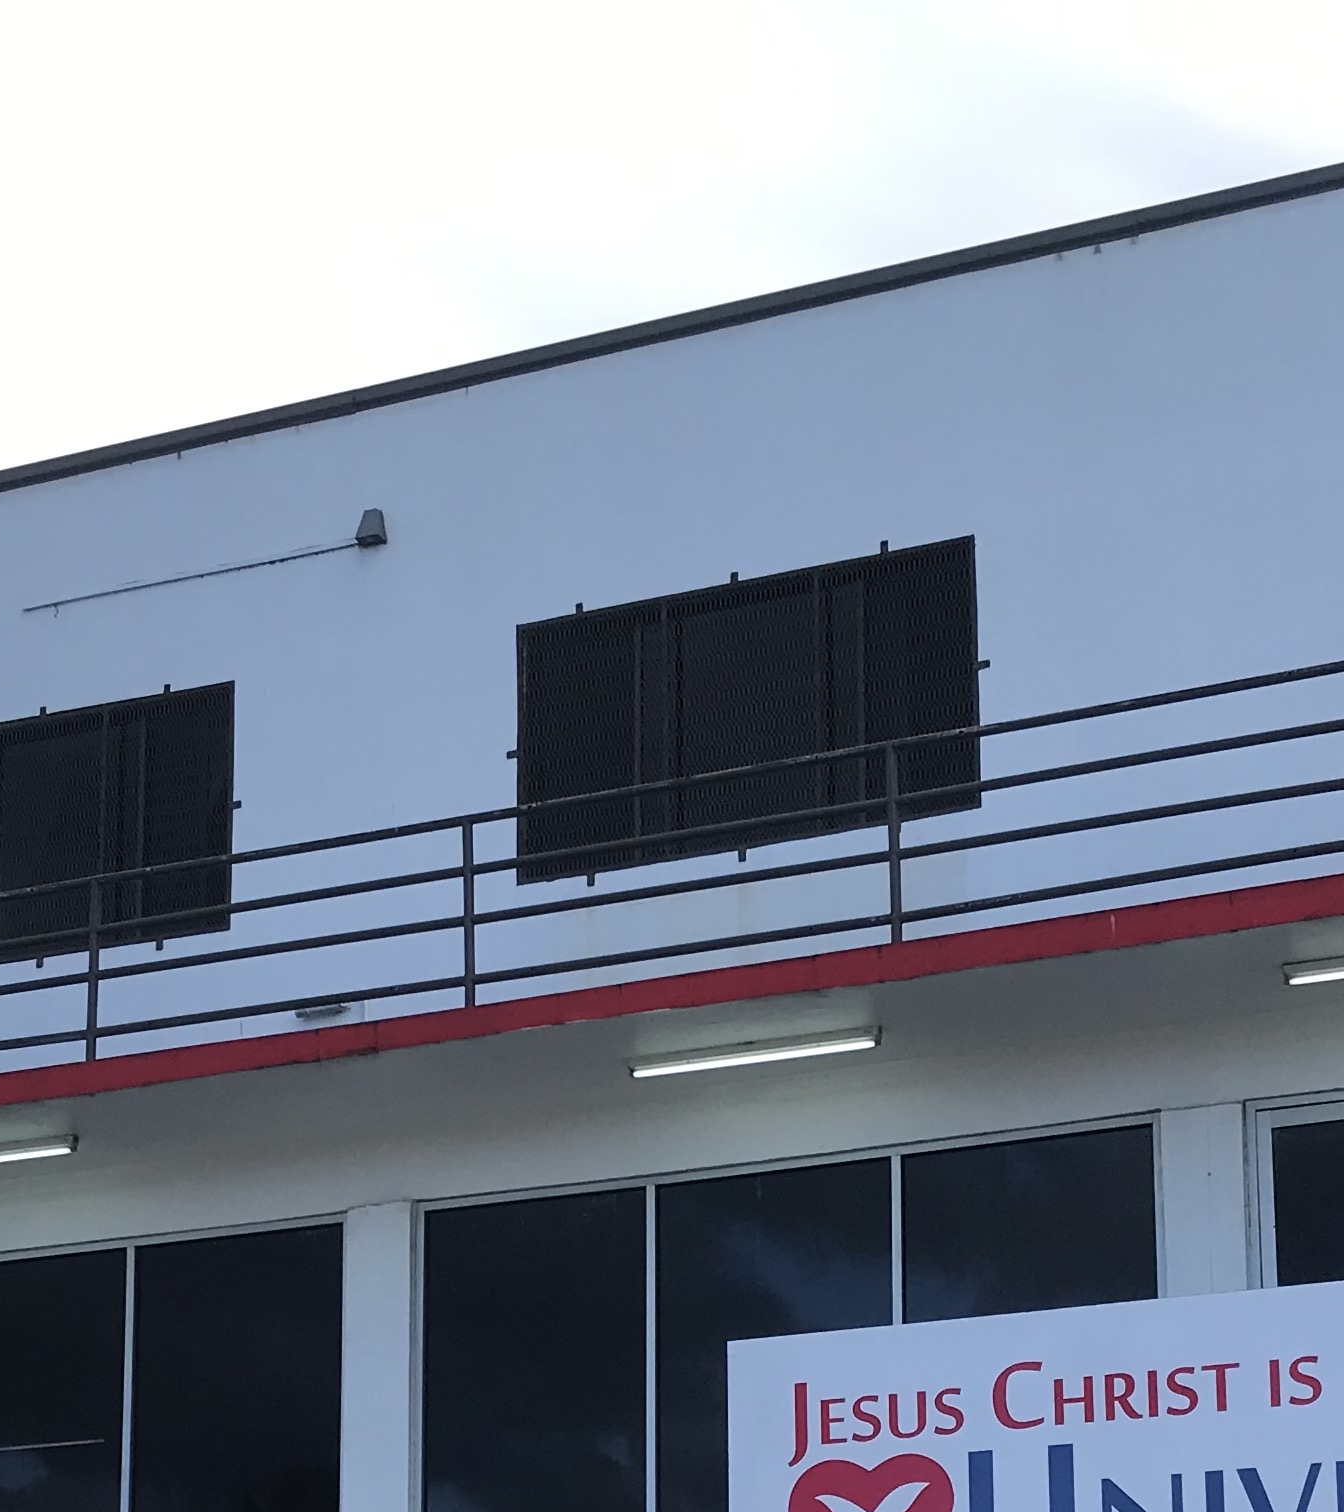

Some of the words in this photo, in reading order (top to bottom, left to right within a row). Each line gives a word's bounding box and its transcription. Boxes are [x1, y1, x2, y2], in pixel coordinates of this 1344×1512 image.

[789, 1382, 964, 1467] JESUS
[992, 1361, 1239, 1430] CHRIST
[1268, 1355, 1323, 1408] IS
